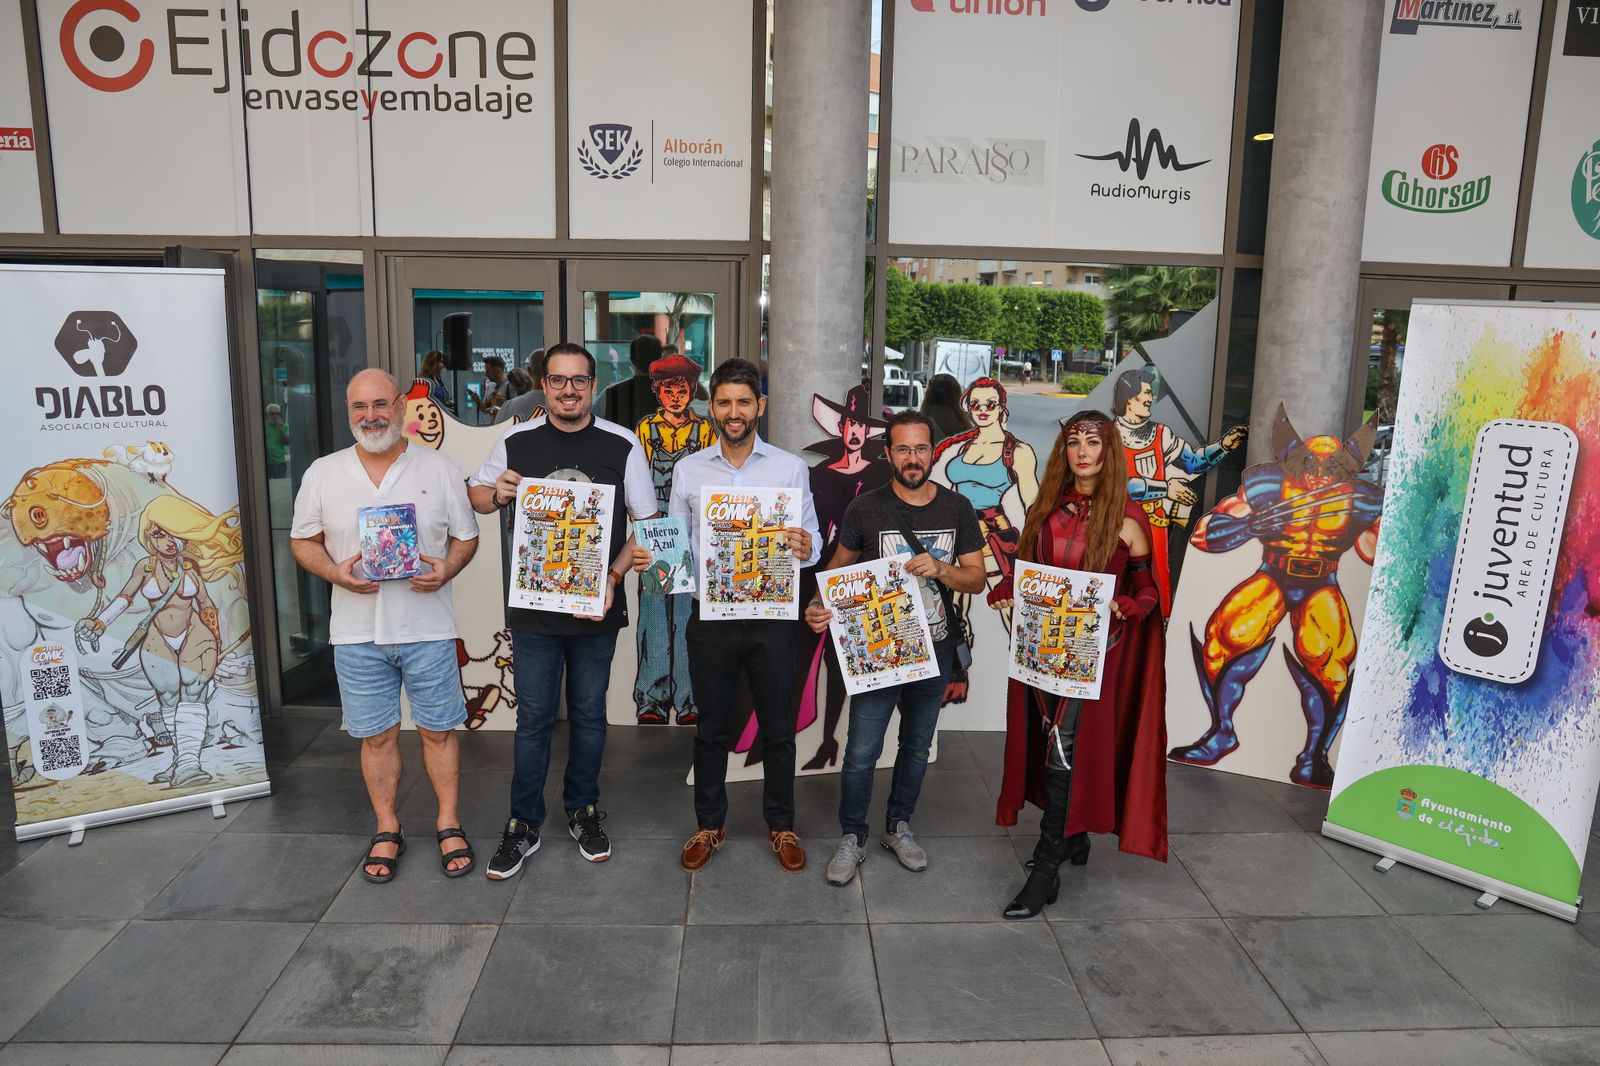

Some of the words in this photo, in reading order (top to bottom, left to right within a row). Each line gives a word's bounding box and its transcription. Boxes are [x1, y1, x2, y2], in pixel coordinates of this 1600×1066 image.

[167, 8, 536, 94] Ejidozone
[245, 83, 534, 121] envaseyembalaje
[593, 129, 629, 151] SEK
[663, 139, 723, 154] Alborán
[663, 157, 691, 168] Colegio
[692, 158, 743, 168] Internacional
[1090, 183, 1191, 204] AudioMurgis
[1381, 170, 1492, 214] Cohorsan
[35, 384, 167, 420] DIABLO
[40, 421, 110, 432] ASOCIACION
[113, 420, 168, 430] CULTURAL
[1530, 448, 1555, 521] CULTURA
[642, 527, 679, 540] Infierno
[1473, 443, 1533, 608] juventud
[651, 539, 676, 552] Azul
[1525, 530, 1539, 550] DE
[1516, 558, 1534, 598] AREA
[1418, 813, 1434, 825] de
[1421, 798, 1512, 834] Ayuntamiento
